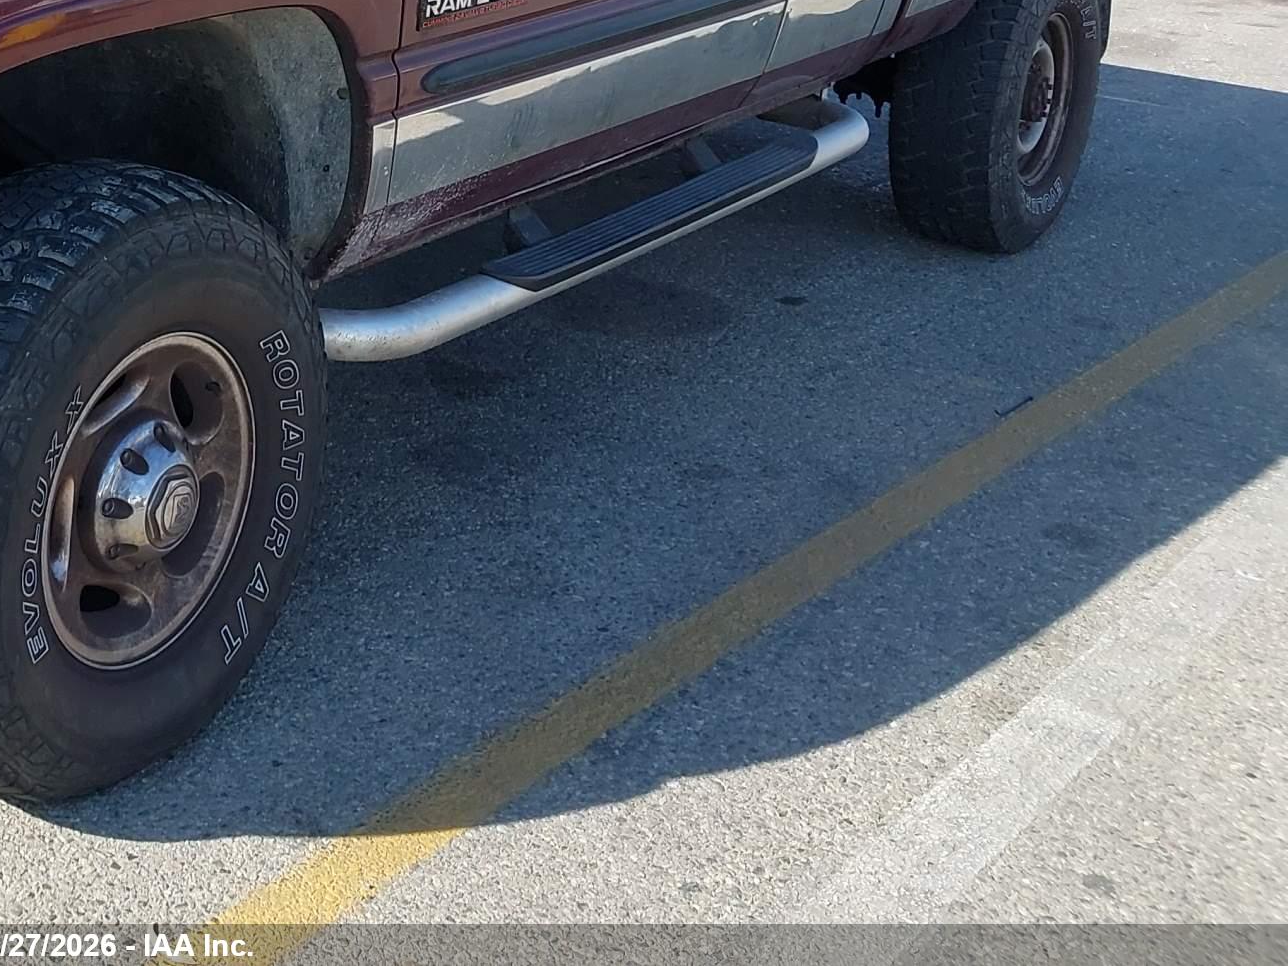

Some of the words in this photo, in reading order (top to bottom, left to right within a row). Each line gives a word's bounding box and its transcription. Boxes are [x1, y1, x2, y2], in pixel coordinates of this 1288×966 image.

[21, 385, 85, 665] EVOLUXX
[259, 329, 306, 559] ROTATOR
[219, 561, 271, 666] A/T
